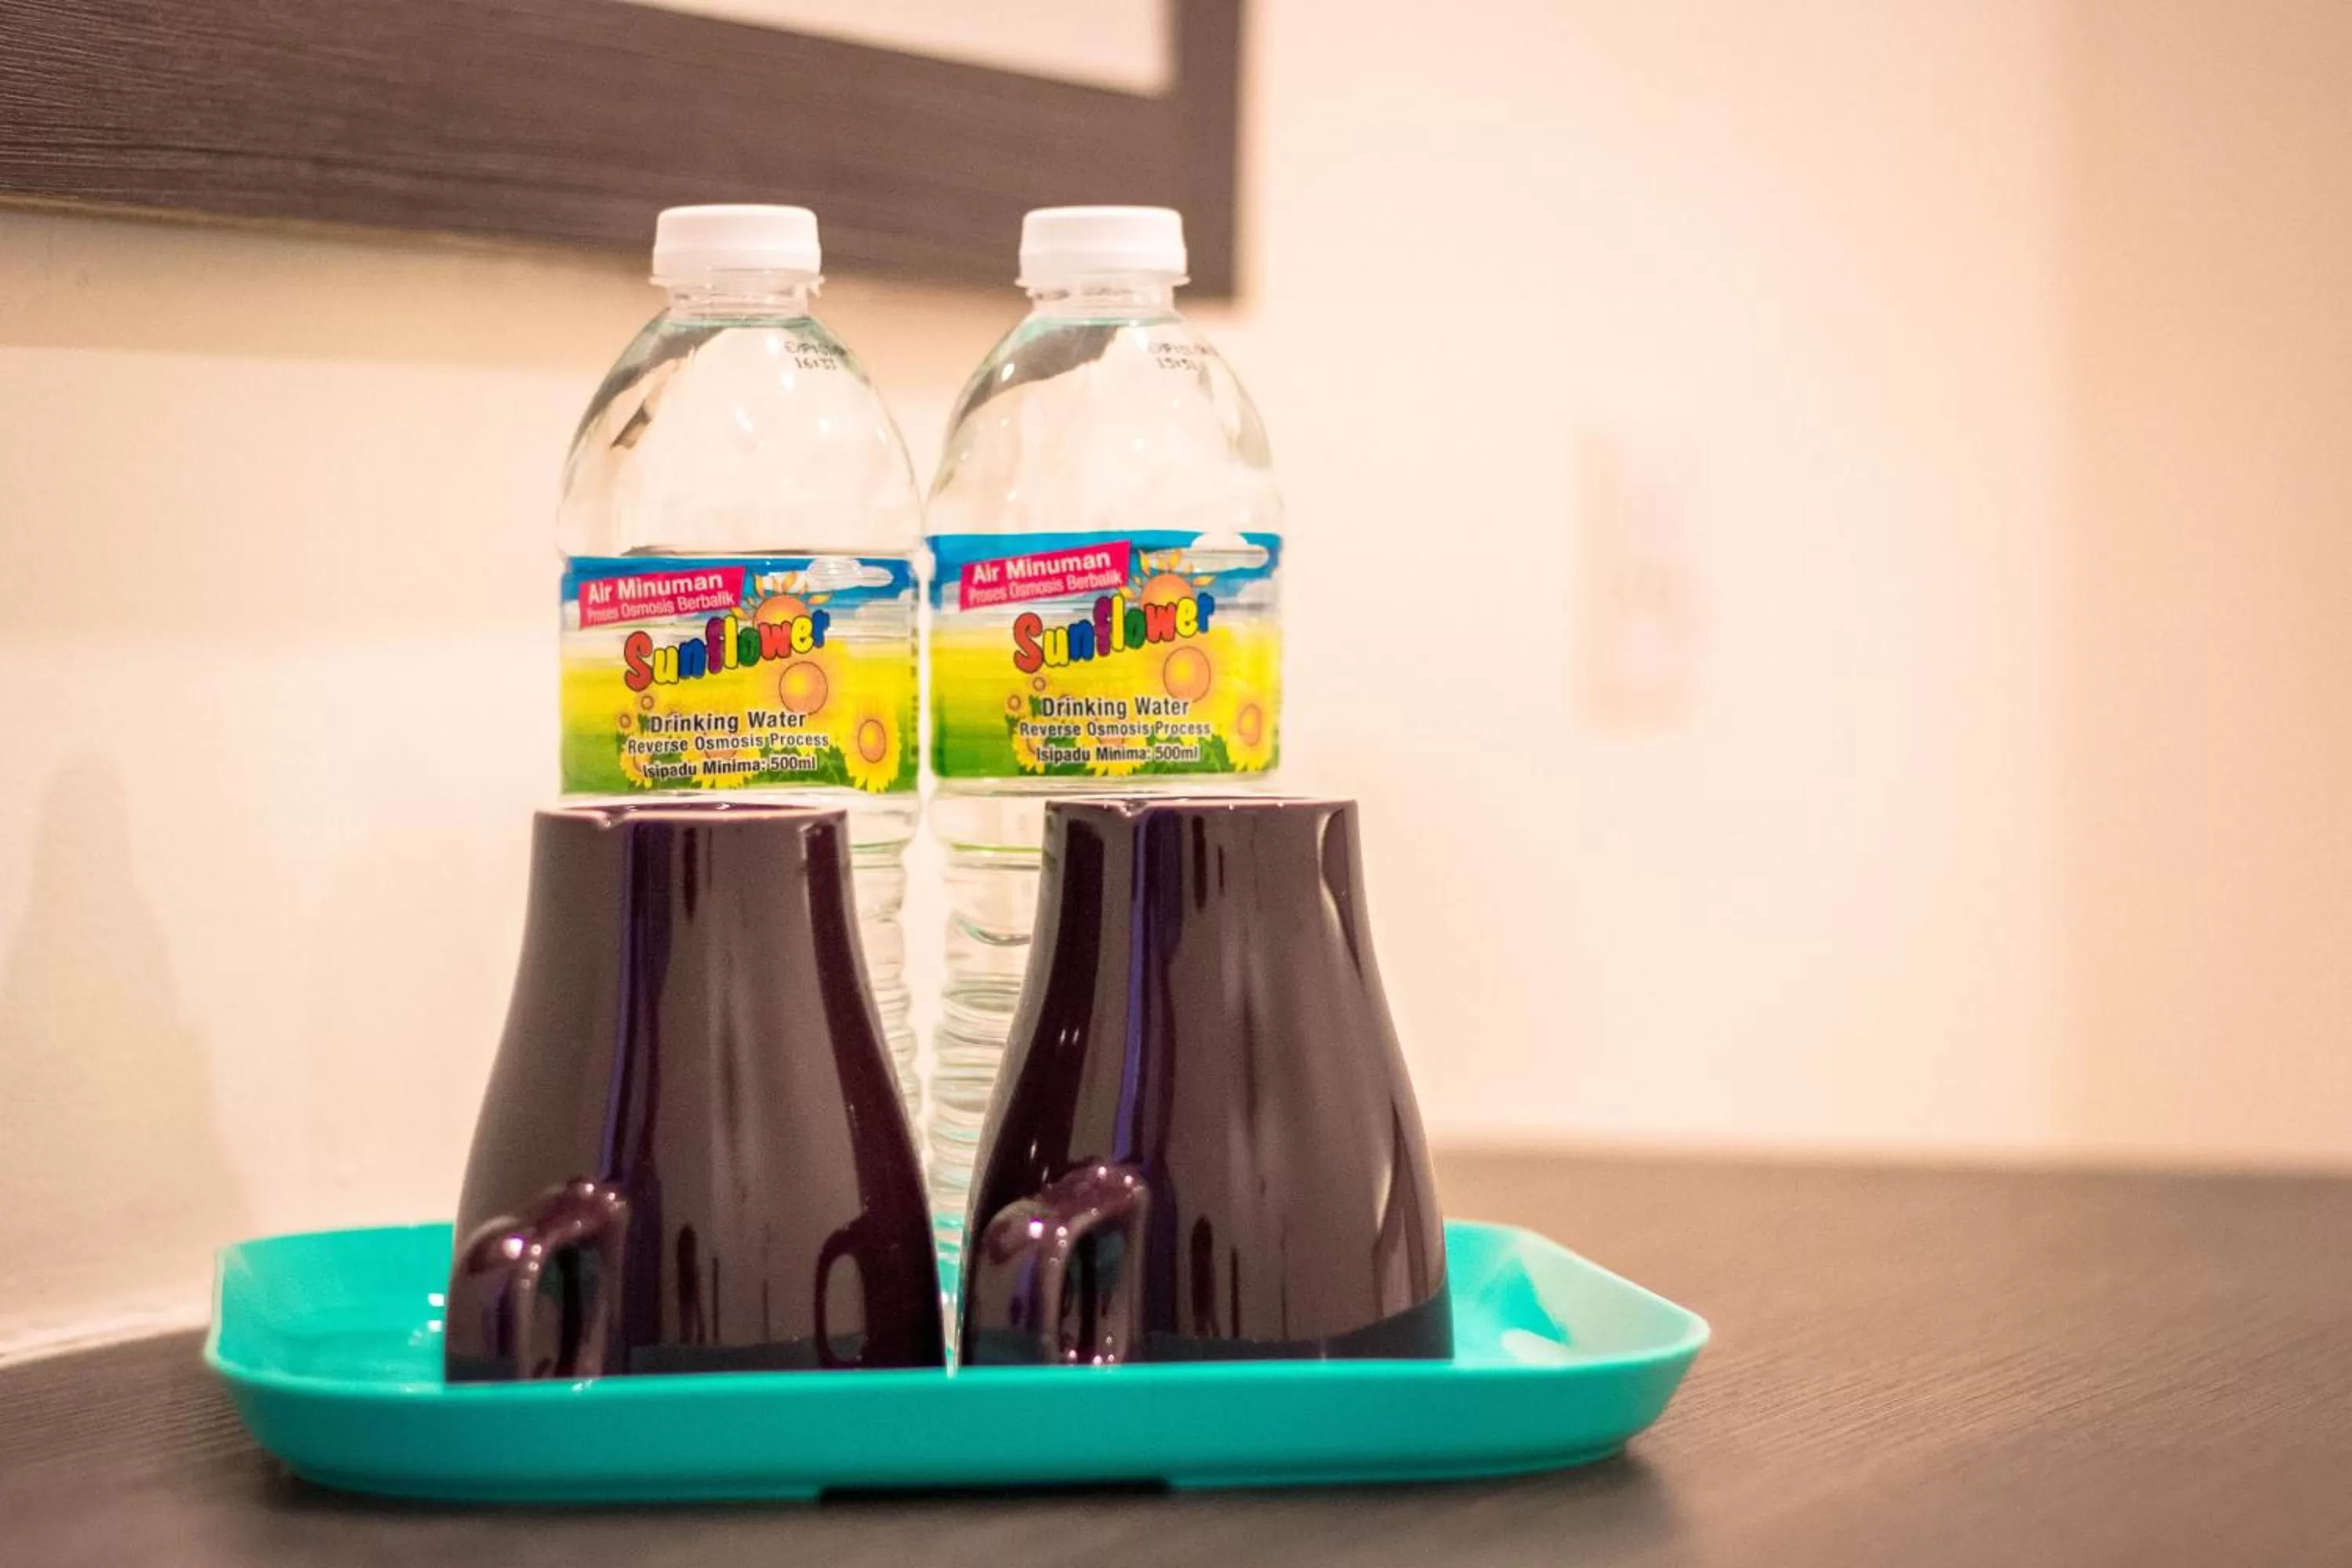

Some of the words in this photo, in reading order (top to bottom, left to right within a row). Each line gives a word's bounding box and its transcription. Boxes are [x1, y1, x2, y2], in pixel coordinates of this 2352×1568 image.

[973, 564, 1000, 585] Air
[1006, 552, 1111, 579] Minuman
[589, 583, 612, 604] Air
[617, 574, 723, 600] Minuman
[1010, 579, 1064, 598] Osmosis
[1066, 569, 1123, 589] Berbalik
[621, 599, 674, 618] Osmosis
[677, 591, 735, 611] Berbalik
[1013, 593, 1216, 673] Sunflower
[623, 609, 831, 691] Sunflower
[1042, 697, 1127, 718] Drinking
[1134, 696, 1189, 716] Water
[650, 714, 739, 734] Drinking
[748, 711, 807, 728] Water
[1020, 722, 1081, 736] Reverse
[1087, 721, 1149, 736] Osmosis
[1154, 721, 1211, 735] Process
[628, 739, 688, 753] Reverse
[695, 734, 764, 750] Osmosis
[770, 733, 829, 746] Process
[1037, 748, 1091, 764] Isipadu
[1098, 747, 1150, 760] Minima:
[1155, 746, 1199, 760] 500ml
[643, 763, 697, 779] Isipadu
[702, 758, 766, 775] Minima:
[771, 756, 816, 770] 500ml
